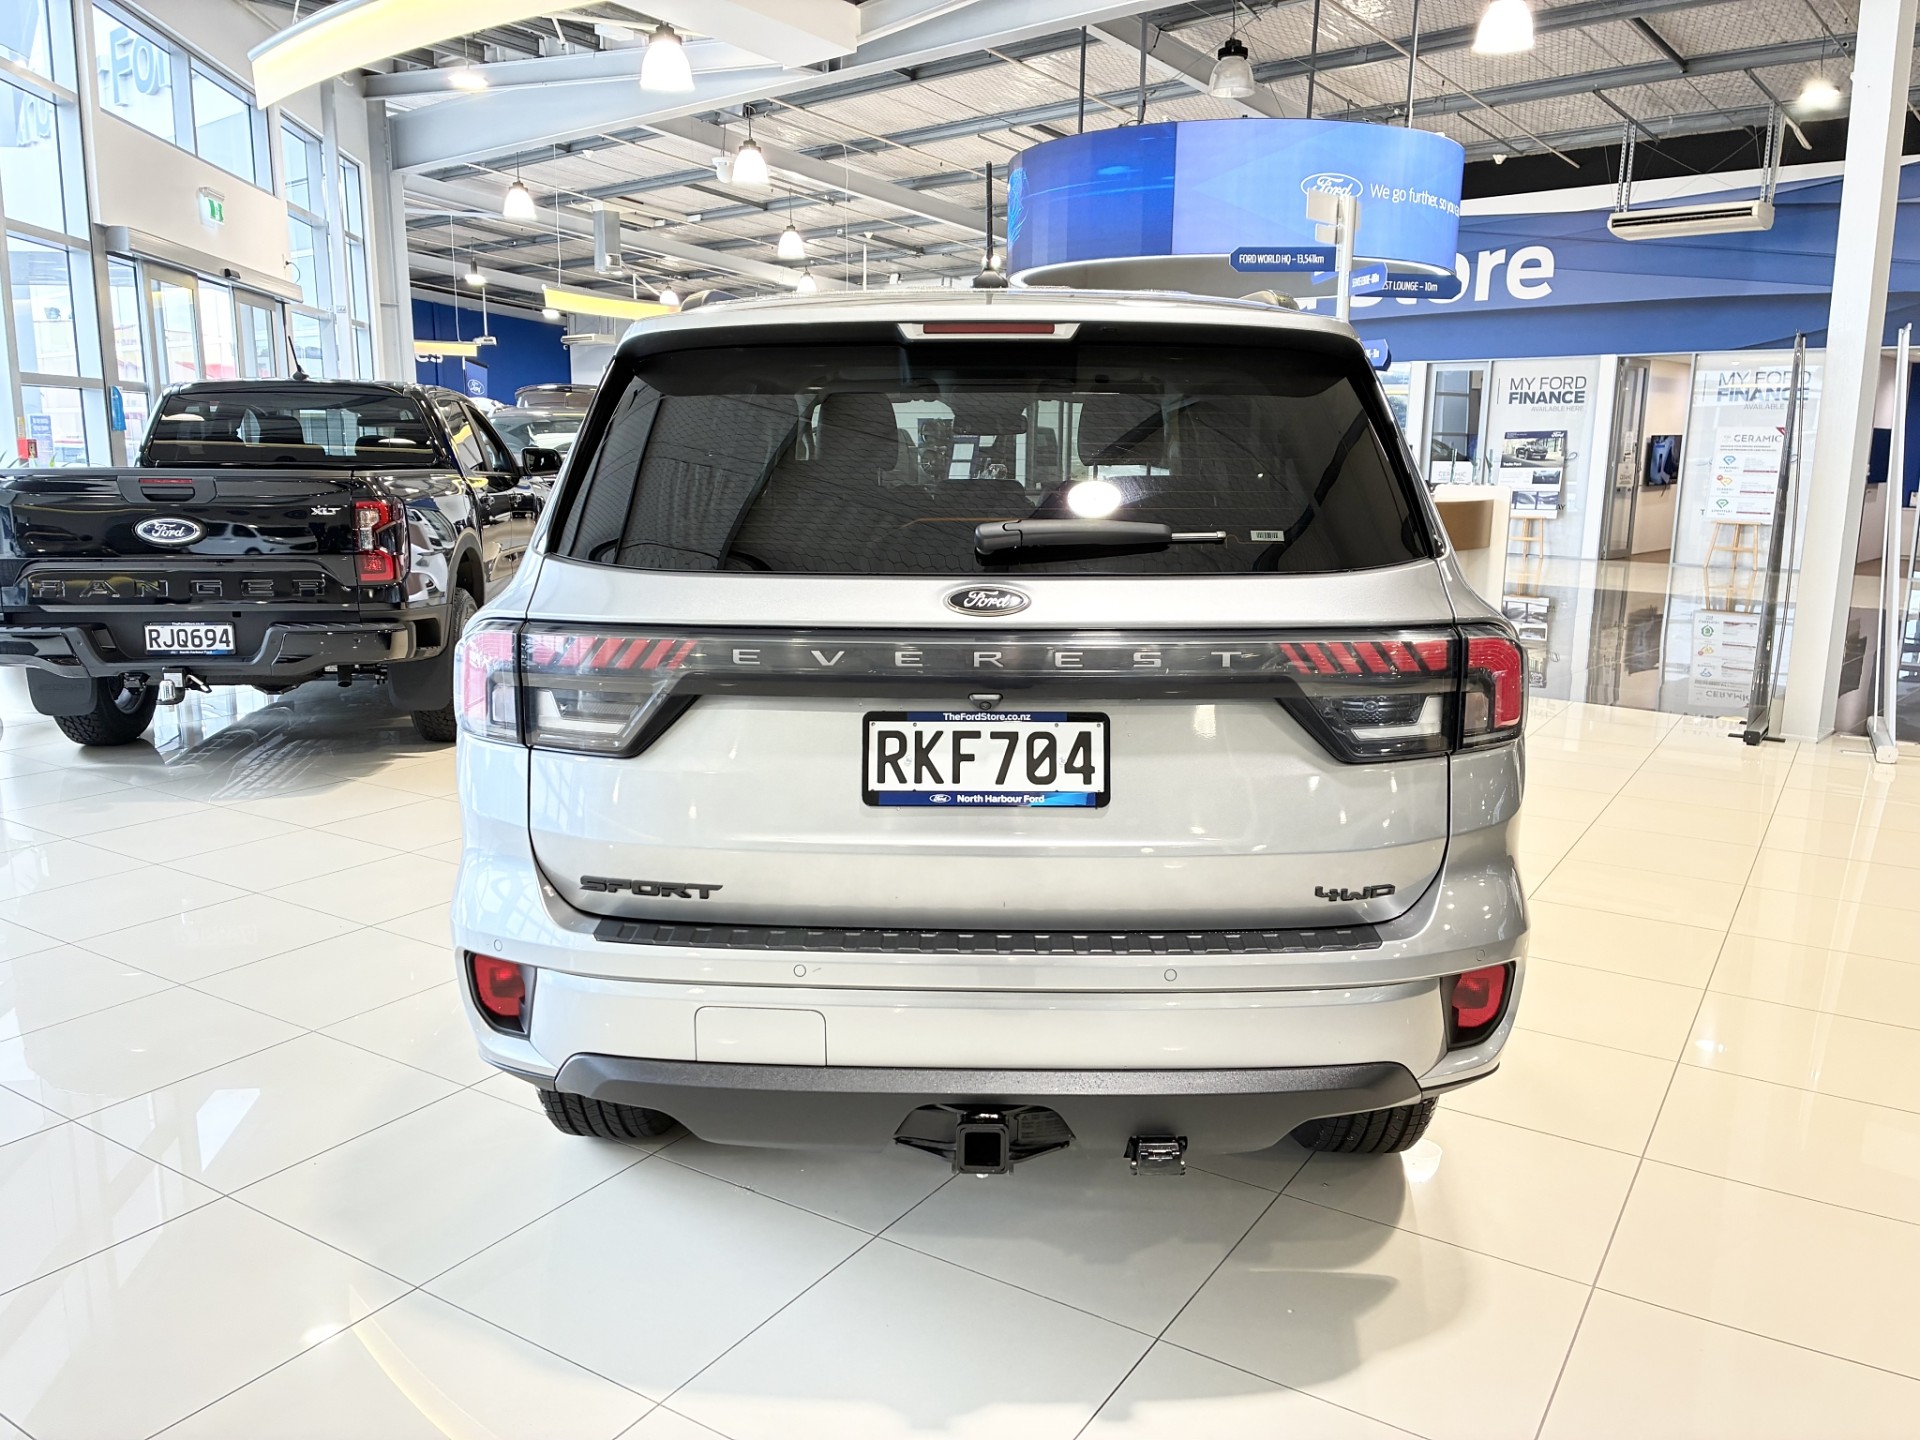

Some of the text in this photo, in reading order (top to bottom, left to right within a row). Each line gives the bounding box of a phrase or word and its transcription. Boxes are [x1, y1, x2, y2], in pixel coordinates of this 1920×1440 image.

[1370, 183, 1390, 199] We
[1392, 189, 1407, 203] go
[1409, 187, 1439, 209] further,
[1439, 199, 1447, 210] so
[1239, 253, 1257, 264] FORD
[1257, 253, 1280, 264] WORLD
[1281, 253, 1291, 266] HQ
[1297, 253, 1325, 265] 13,541km
[1394, 281, 1419, 291] LOUNGE
[1424, 281, 1438, 292] 10m
[1510, 376, 1587, 390] MY FORD
[1718, 371, 1750, 387] MY
[1508, 390, 1586, 405] FINANCE
[1717, 387, 1810, 402] FINANCE
[1733, 434, 1782, 443] CERAMIC
[310, 505, 342, 516] XLT
[151, 523, 184, 538] Ford
[31, 578, 326, 599] RANGER
[963, 590, 1011, 608] Ford
[148, 628, 231, 648] RJQ694
[731, 648, 1242, 668] EVEREST
[943, 712, 1031, 721] TheFordStore.co.nz
[877, 730, 1095, 785] RKF704
[957, 794, 983, 803] North
[984, 794, 1022, 803] Harbour
[1023, 794, 1045, 803] Ford
[579, 875, 724, 900] SPORT
[1314, 884, 1396, 902] 4WD
